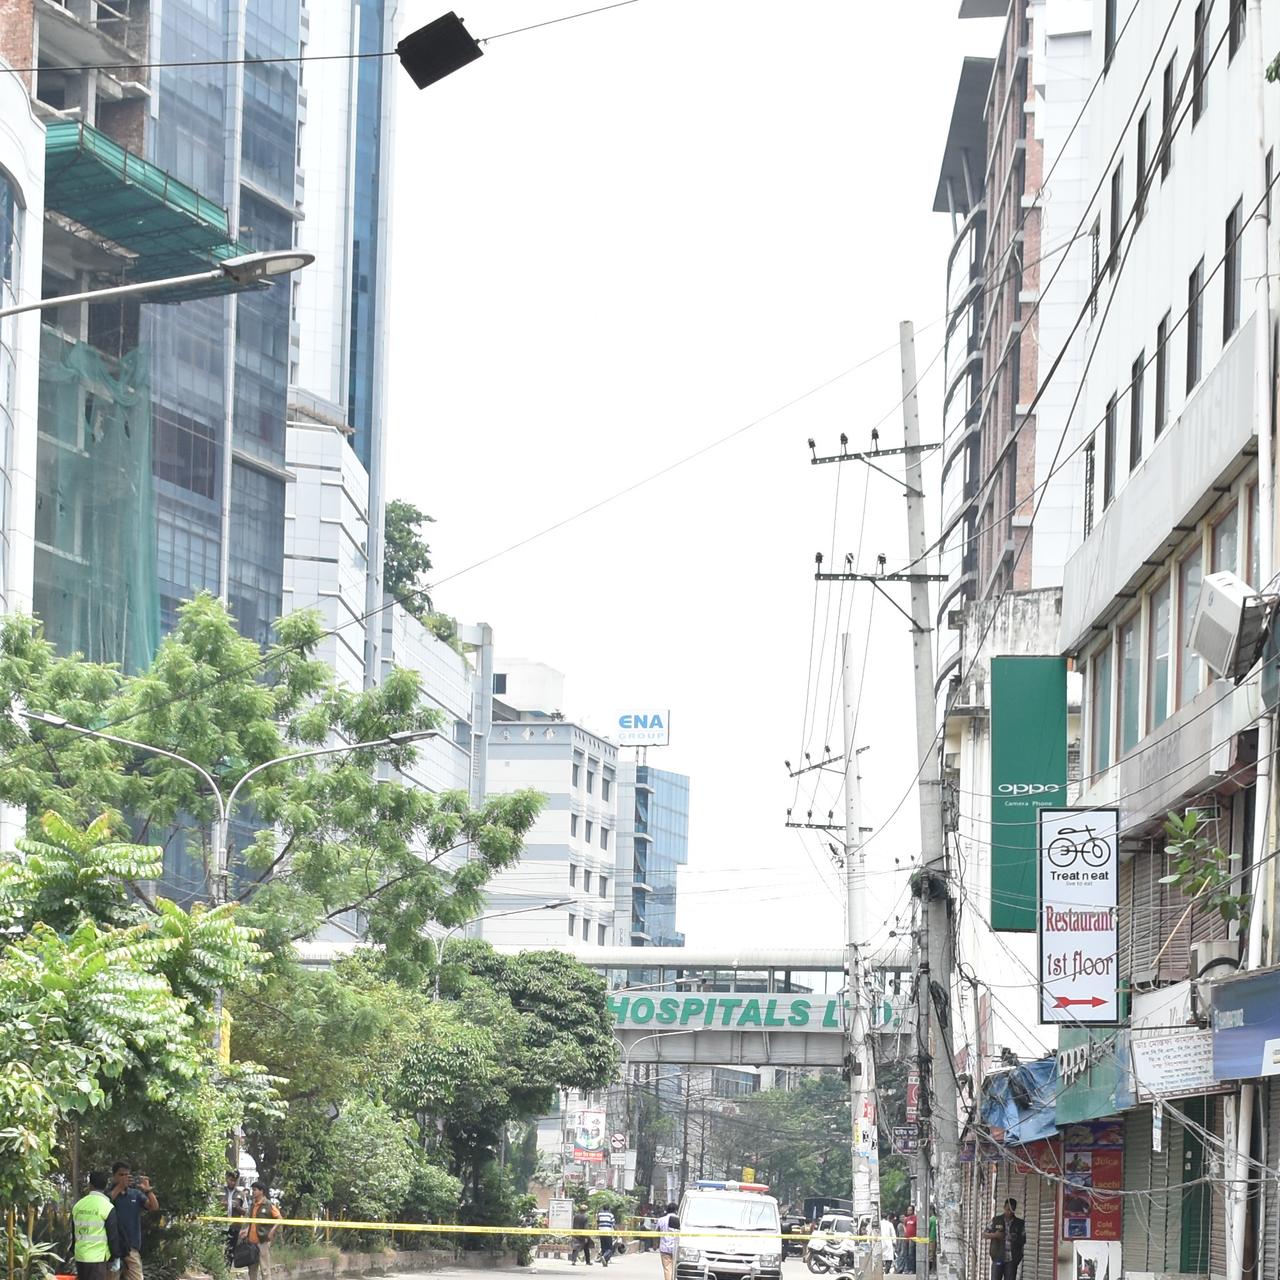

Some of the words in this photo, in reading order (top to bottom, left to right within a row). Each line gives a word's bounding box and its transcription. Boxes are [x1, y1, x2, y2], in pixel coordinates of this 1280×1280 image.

[619, 713, 664, 729] ENA
[618, 732, 665, 740] GROUP
[998, 783, 1060, 795] oppo
[1045, 905, 1115, 932] Restaurant
[1047, 953, 1067, 976] 1st
[1071, 950, 1113, 982] floor
[607, 996, 812, 1027] HOSPITALS
[822, 999, 900, 1028] LD.
[1059, 1045, 1088, 1086] oppo
[1095, 1156, 1118, 1167] Juice
[1093, 1179, 1119, 1190] Lacchi
[1092, 1201, 1119, 1213] Coffee
[1097, 1221, 1112, 1229] Cold
[1095, 1228, 1116, 1237] Coffee
